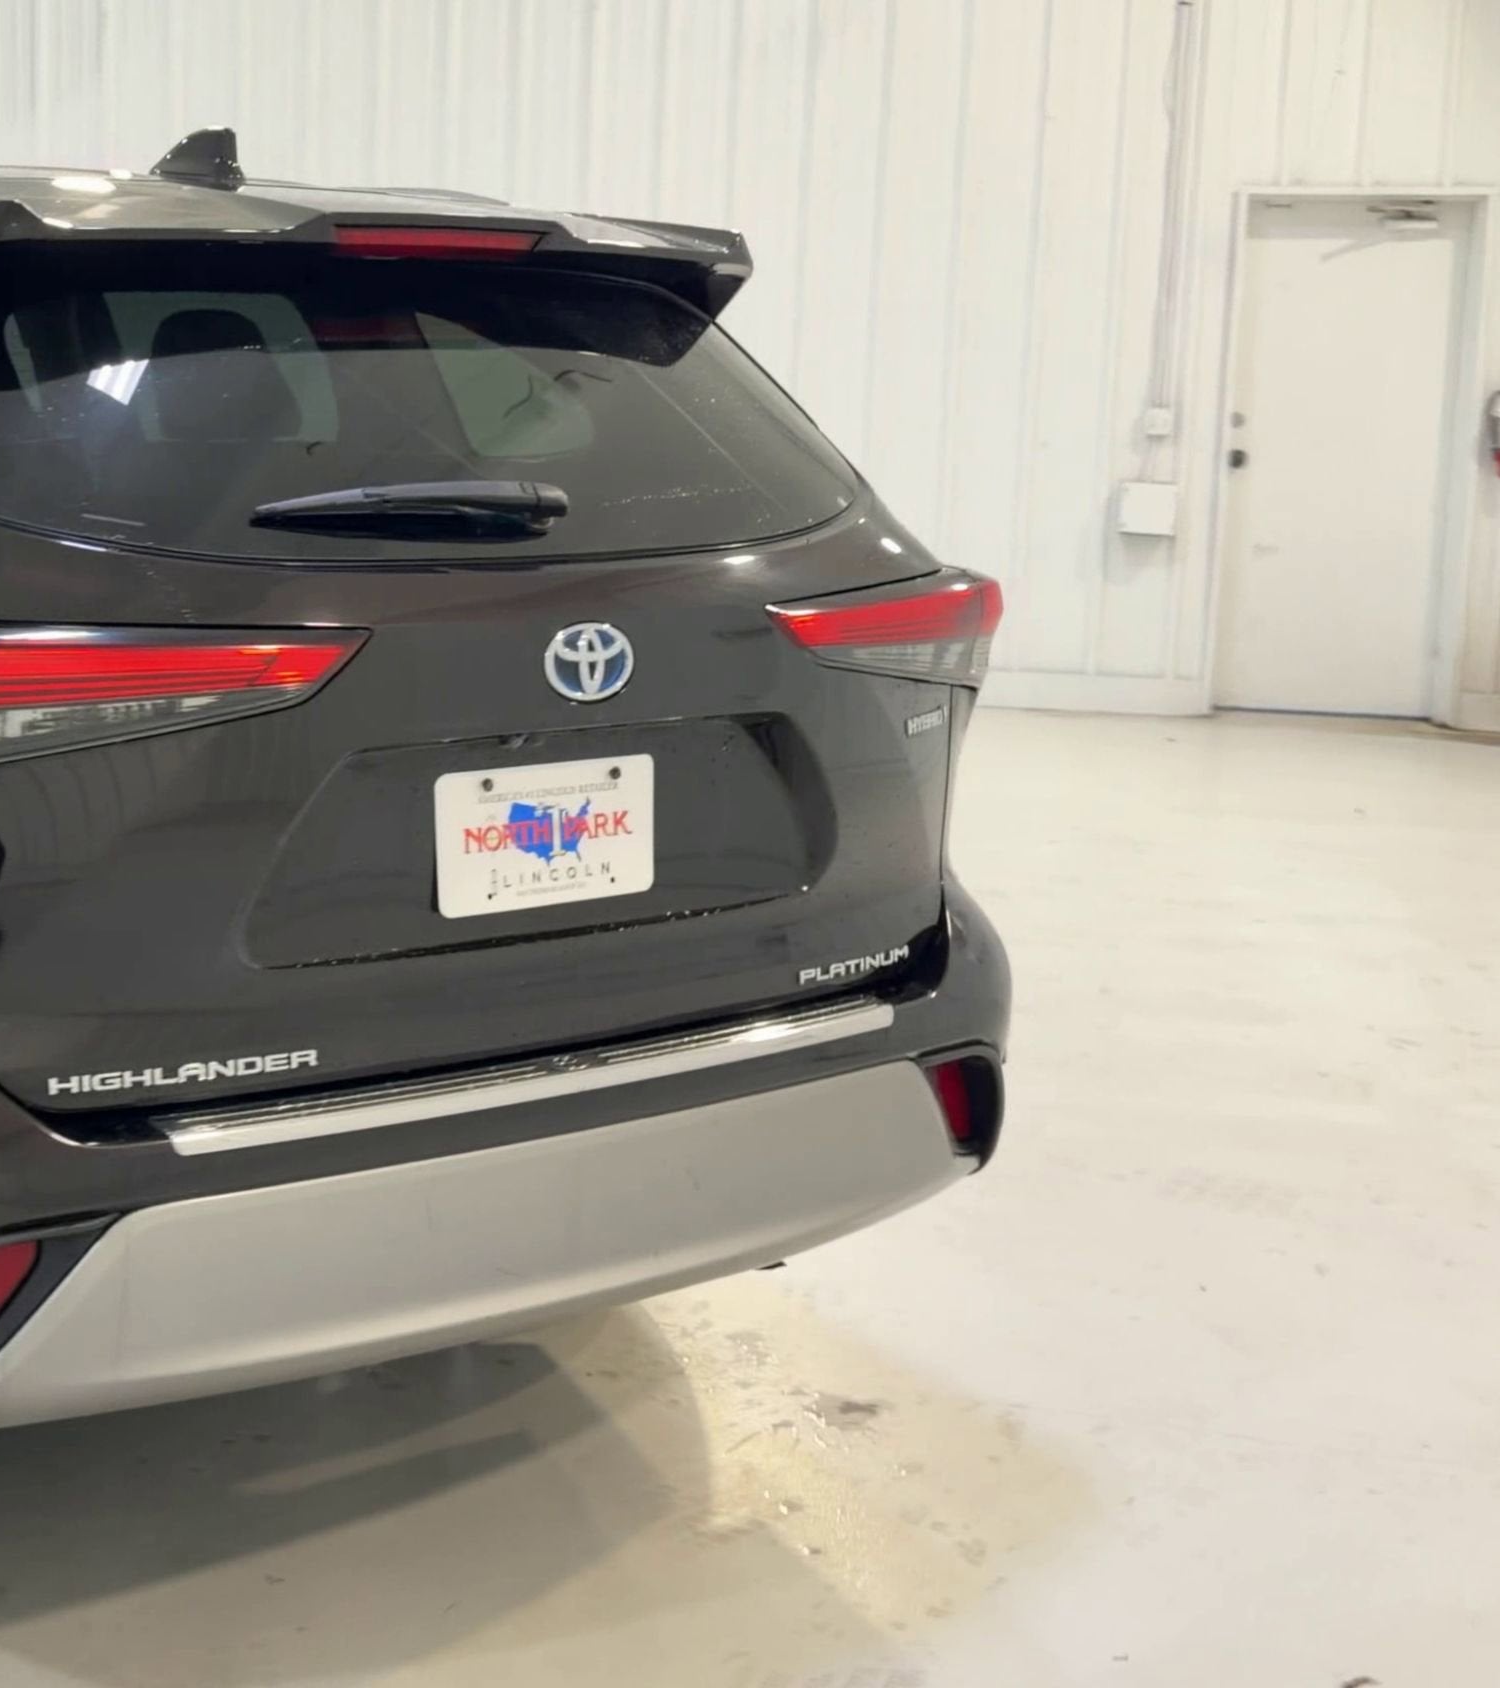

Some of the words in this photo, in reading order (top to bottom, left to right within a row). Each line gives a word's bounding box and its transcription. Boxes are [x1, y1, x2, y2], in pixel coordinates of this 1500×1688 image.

[907, 707, 946, 736] HYBRID
[463, 819, 550, 854] NORTH
[564, 811, 632, 842] PARK
[503, 861, 611, 888] LINCOLN
[799, 944, 910, 985] PLATINUM
[48, 1049, 319, 1096] HIGHLANDER
